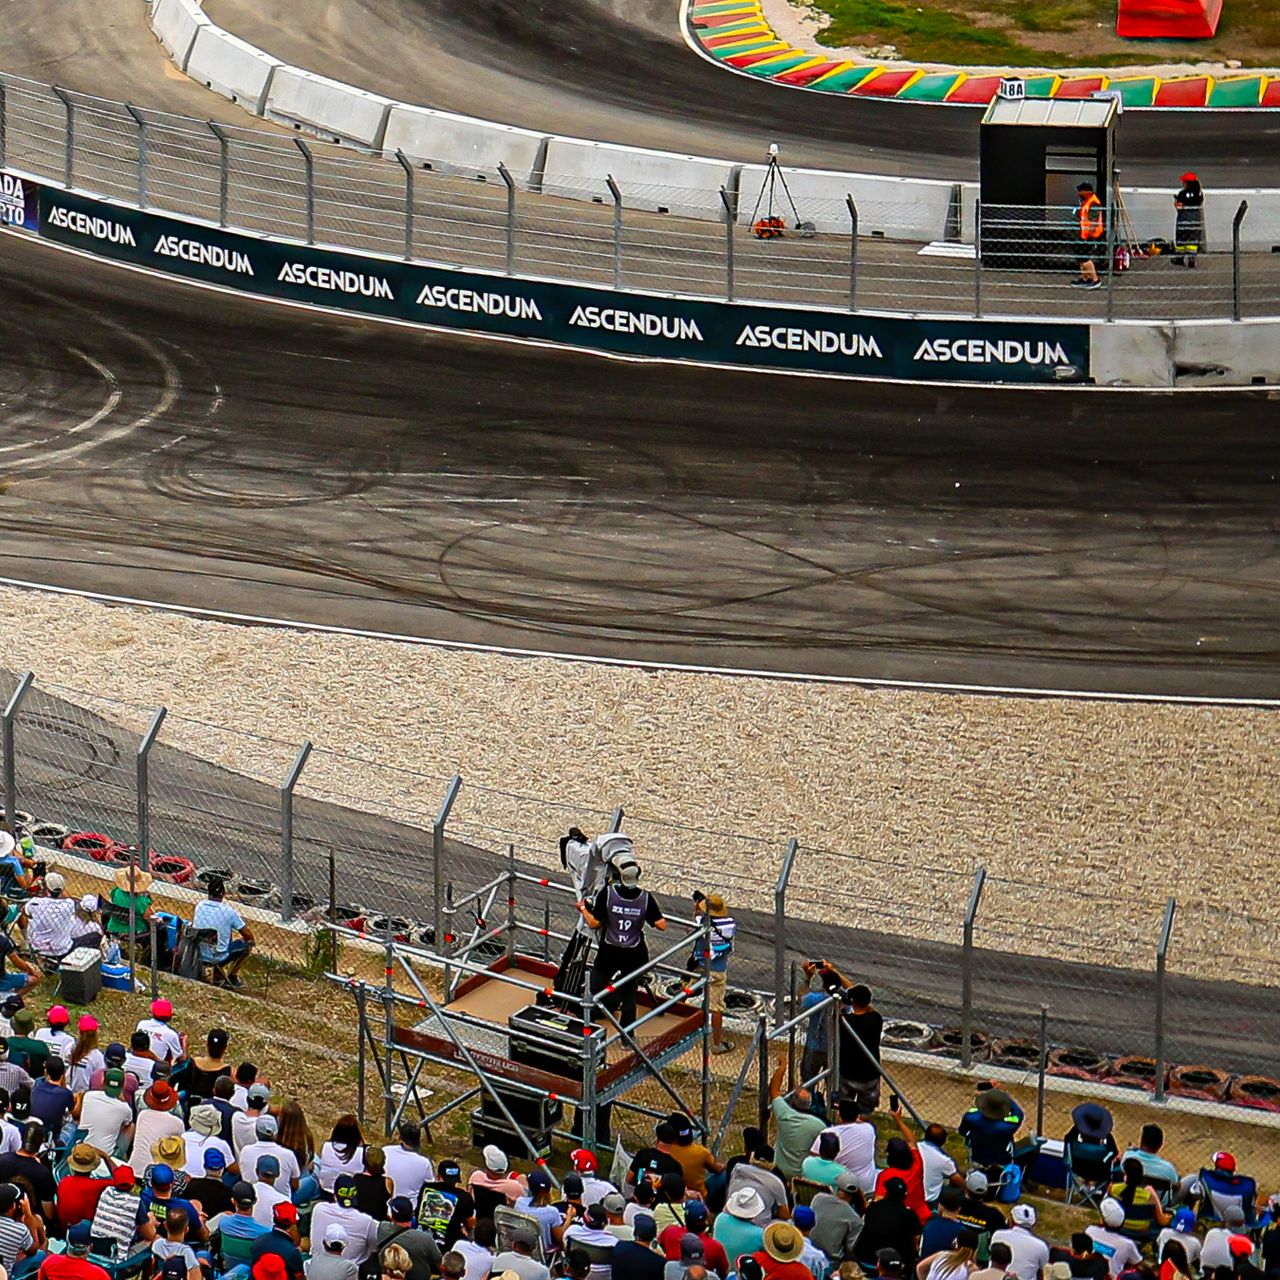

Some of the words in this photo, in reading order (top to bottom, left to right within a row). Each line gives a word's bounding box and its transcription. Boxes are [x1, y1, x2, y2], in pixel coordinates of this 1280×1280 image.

[48, 205, 137, 248] ASCENDUM
[153, 234, 255, 277] ASCENDUM
[277, 261, 395, 301] ASCENDUM
[415, 284, 543, 322] ASCENDUM
[568, 306, 704, 341] ASCENDUM
[735, 324, 884, 359] ASCENDUM
[913, 338, 1070, 364] ASCENDUM
[618, 919, 632, 931] 19
[618, 934, 629, 942] TV
